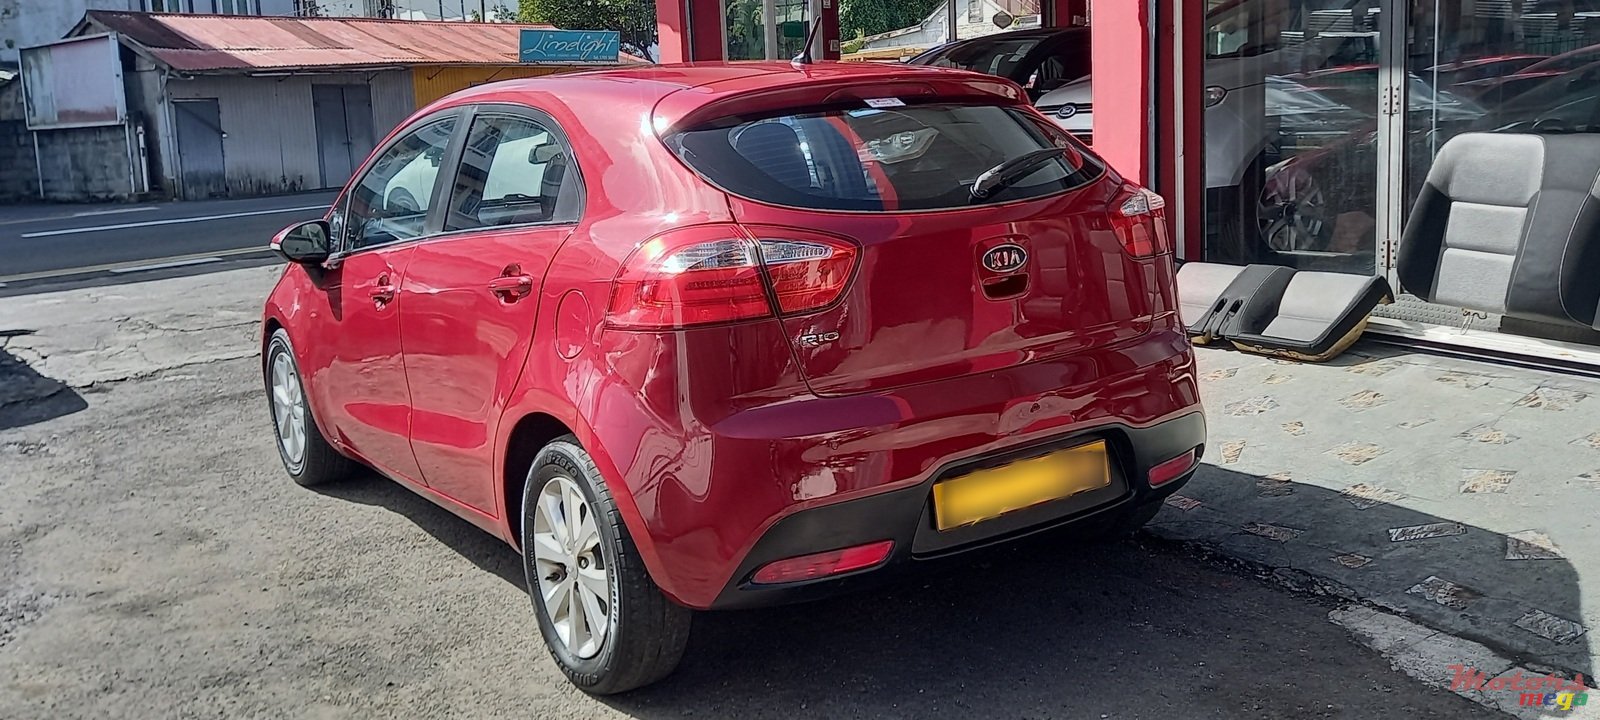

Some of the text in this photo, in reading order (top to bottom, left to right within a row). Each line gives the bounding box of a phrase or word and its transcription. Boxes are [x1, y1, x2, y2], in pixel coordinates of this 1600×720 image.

[523, 32, 618, 60] Limelight
[990, 250, 1021, 268] KIA
[800, 332, 840, 346] RIO
